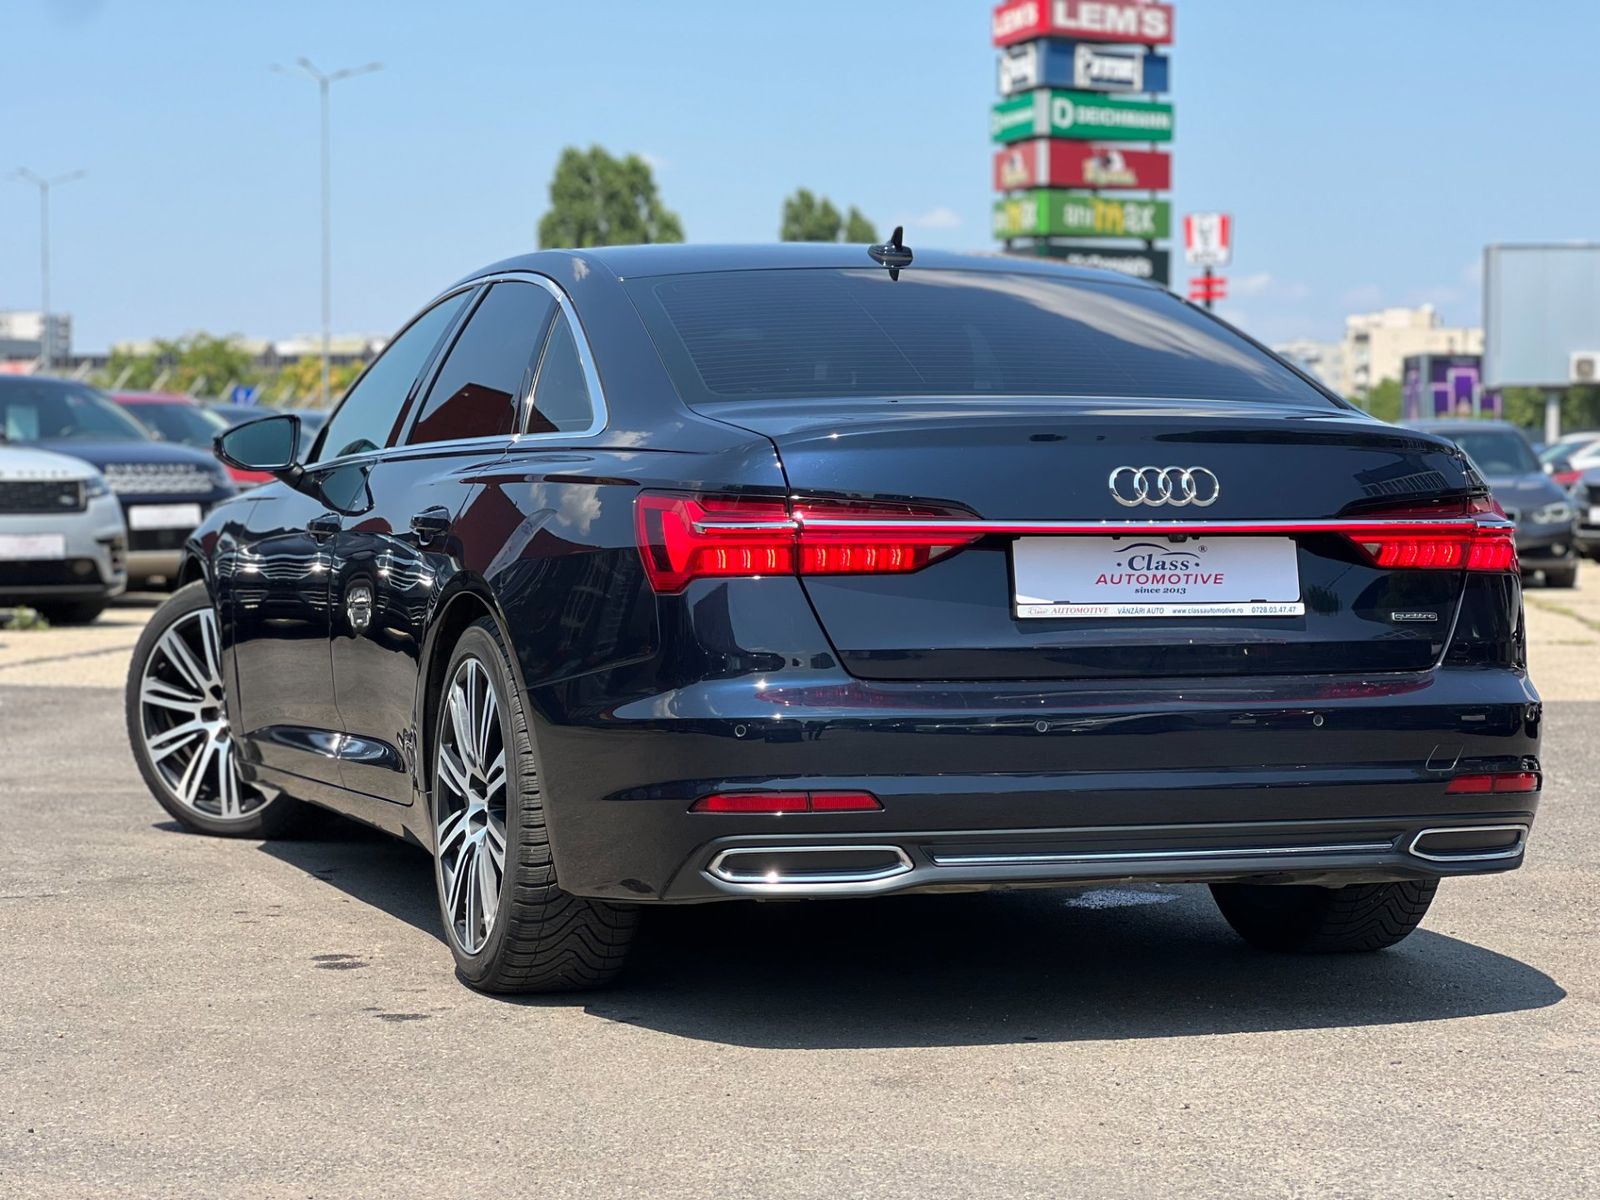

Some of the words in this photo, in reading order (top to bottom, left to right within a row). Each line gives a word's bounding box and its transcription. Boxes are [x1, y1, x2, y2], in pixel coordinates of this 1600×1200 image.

[1053, 0, 1168, 38] LEM'S
[1127, 553, 1190, 572] Class
[1095, 573, 1225, 585] AUTOMOTIVE
[1134, 586, 1161, 594] since
[1162, 587, 1187, 595] 2013
[1050, 606, 1109, 615] AUTOMOTIVE
[1146, 607, 1165, 615] AUTO
[1172, 606, 1244, 615] www.classautomotive.ro
[1251, 605, 1297, 614] 0728.03.47.47
